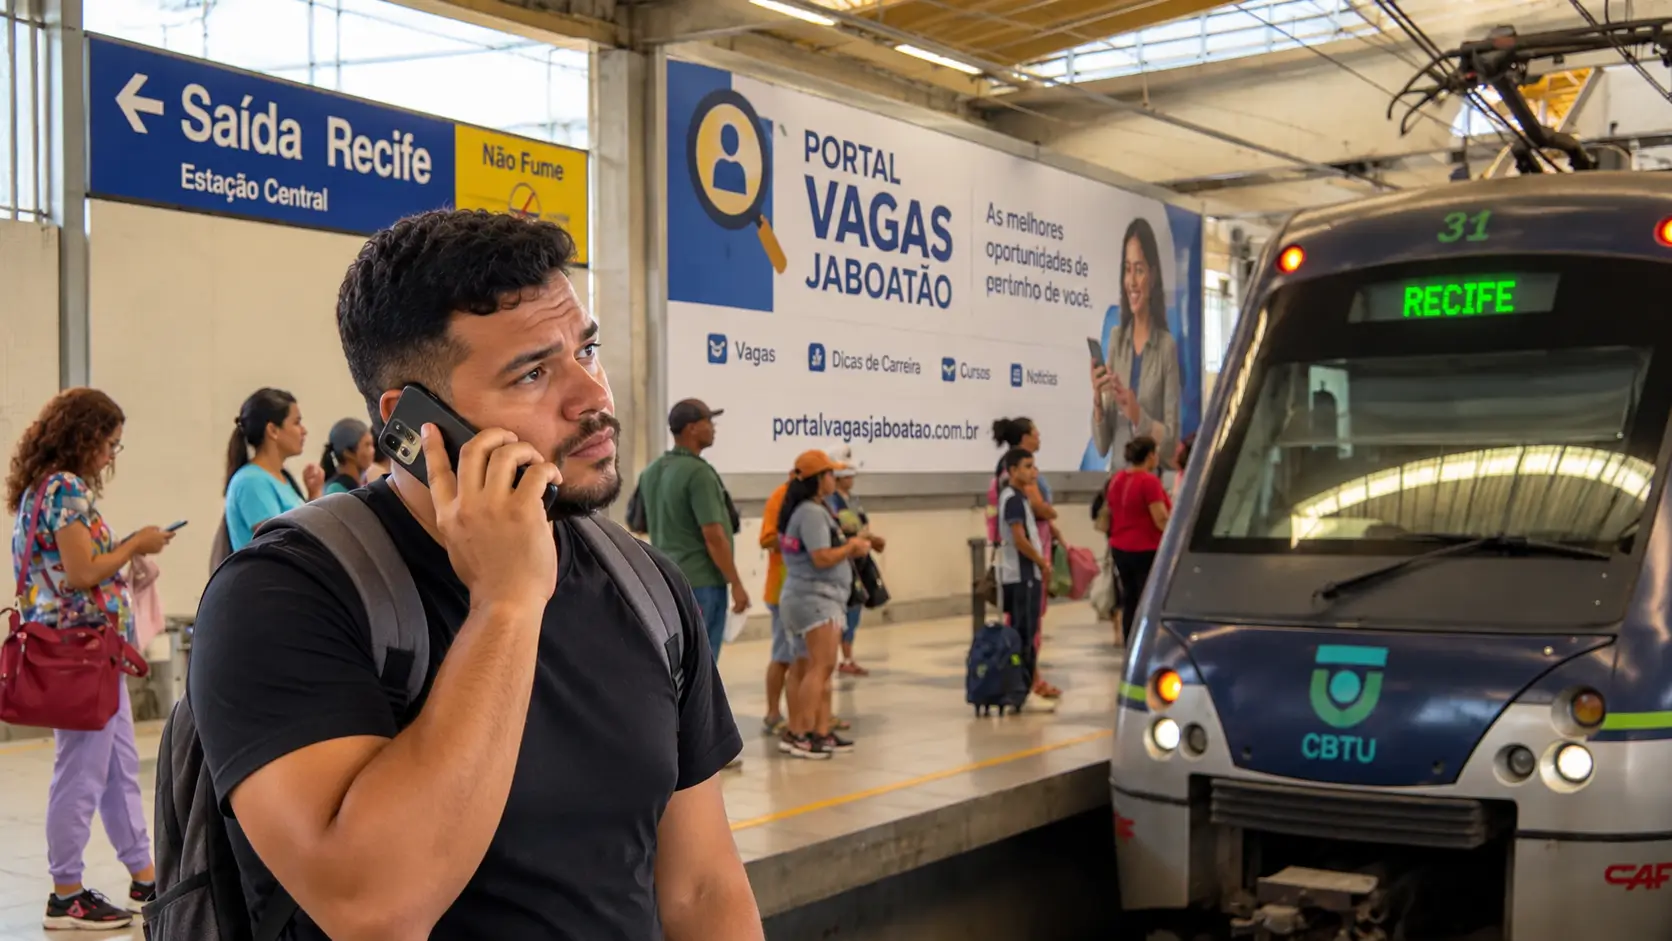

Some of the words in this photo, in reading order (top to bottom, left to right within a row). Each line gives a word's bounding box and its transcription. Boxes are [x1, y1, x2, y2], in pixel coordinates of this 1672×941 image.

[180, 82, 302, 161] Saída
[326, 115, 432, 185] Recife
[482, 142, 516, 171] Não
[521, 151, 564, 181] Fume
[804, 129, 901, 185] PORTAL
[180, 162, 259, 203] Estação
[264, 178, 328, 212] Central
[804, 174, 953, 263] VAGAS
[986, 201, 1003, 227] As
[1006, 211, 1064, 241] melhores
[1437, 210, 1492, 243] 31
[986, 241, 1072, 275] oportunidades
[1075, 255, 1089, 278] de
[804, 252, 952, 310] JABOATÃO
[1044, 280, 1060, 304] de
[1403, 280, 1517, 317] RECIFE
[734, 340, 776, 367] Vagas
[832, 350, 863, 370] Dicas
[865, 353, 880, 372] de
[881, 354, 921, 375] Carreira
[960, 361, 991, 381] Cursos
[772, 412, 979, 444] portalvagasjaboatao.com.br
[1302, 732, 1377, 763] CBTU
[1604, 862, 1672, 891] CAF
